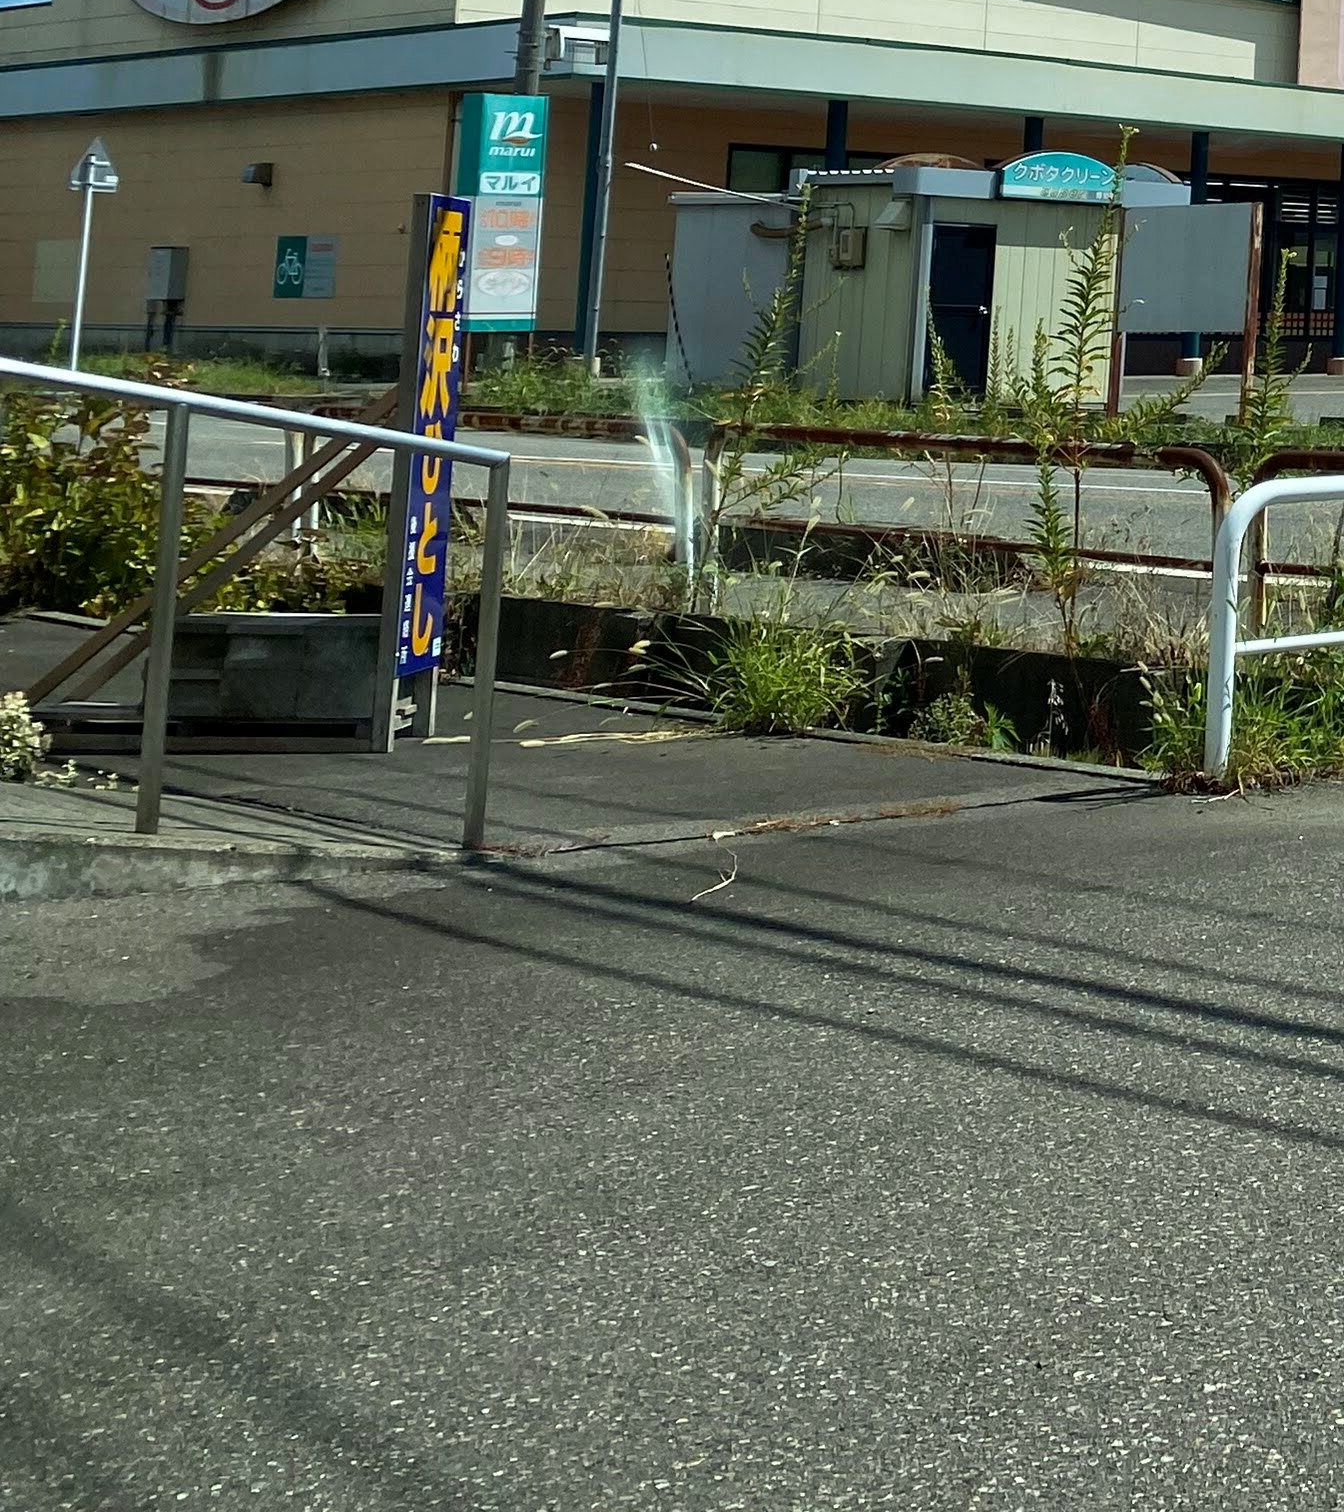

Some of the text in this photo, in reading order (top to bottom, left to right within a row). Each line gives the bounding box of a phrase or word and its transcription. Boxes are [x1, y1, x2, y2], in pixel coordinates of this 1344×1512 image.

[489, 146, 536, 157] marui
[1014, 163, 1115, 186] クボタクリーン
[485, 175, 536, 192] マルイ
